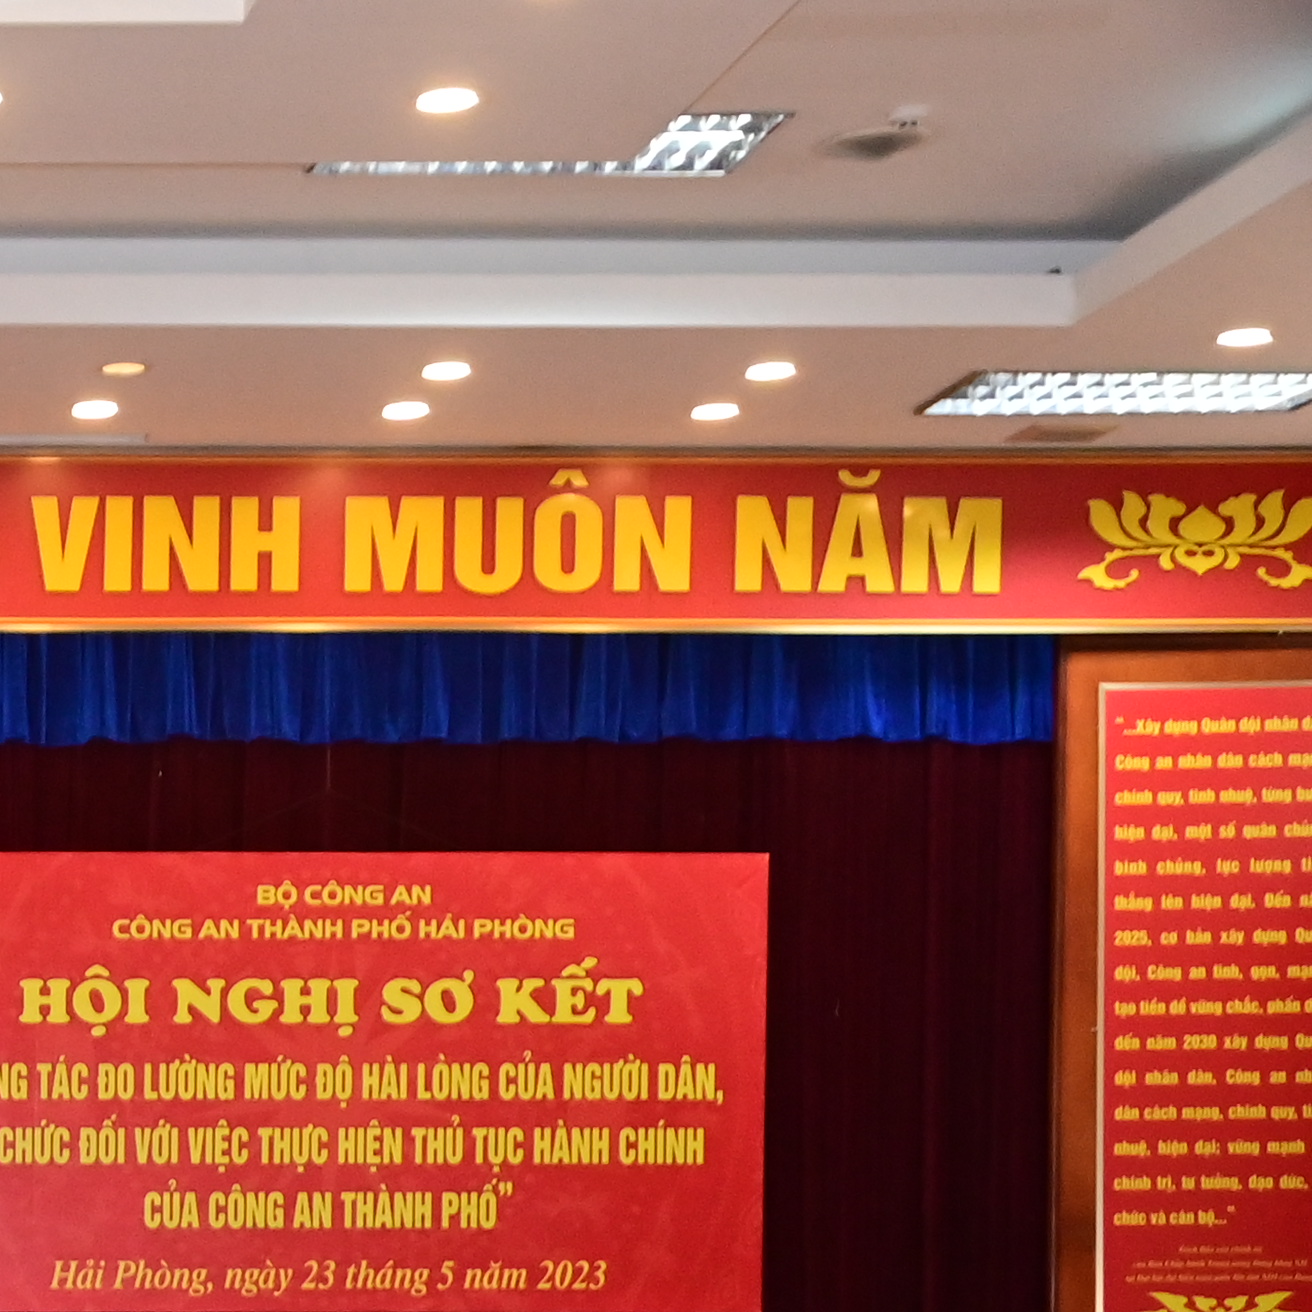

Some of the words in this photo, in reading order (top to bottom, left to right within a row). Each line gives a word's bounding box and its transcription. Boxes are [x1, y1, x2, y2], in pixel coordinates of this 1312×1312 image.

[31, 496, 300, 592] VINH
[344, 471, 691, 594] MUÔN
[735, 471, 1002, 594] NĂM
[257, 880, 297, 910] BỘ
[304, 880, 384, 906] CÔNG
[390, 885, 431, 905] AN
[113, 914, 192, 939] CÔNG
[199, 919, 239, 939] AN
[247, 914, 343, 939] THÀNH
[352, 911, 411, 939] PHỐ
[419, 914, 465, 939] HẢI
[474, 914, 574, 939] PHÒNG
[19, 965, 149, 1036] HỘI
[172, 978, 359, 1037] NGHỊ
[381, 970, 474, 1024] SƠ
[496, 957, 643, 1024] KẾT
[1183, 1034, 1218, 1049] 2030
[37, 1056, 88, 1100] TÁC
[98, 1063, 134, 1100] ĐO
[144, 1054, 234, 1100] LƯỜNG
[245, 1055, 306, 1100] MỨC
[316, 1055, 352, 1108] ĐỘ
[362, 1055, 407, 1100] HÀI
[417, 1054, 489, 1100] LÒNG
[499, 1051, 554, 1100] CỦA
[564, 1054, 648, 1100] NGƯỜI
[658, 1055, 723, 1104] DÂN,
[79, 1114, 125, 1164] ĐỐI
[135, 1120, 178, 1164] VỚI
[188, 1119, 249, 1172] VIỆC
[258, 1124, 328, 1172] THỰC
[338, 1120, 402, 1172] HIỆN
[411, 1115, 463, 1164] THỦ
[472, 1127, 524, 1172] TỤC
[534, 1120, 609, 1164] HÀNH
[619, 1120, 704, 1165] CHÍNH
[144, 1179, 199, 1229] CỦA
[209, 1184, 284, 1229] CÔNG
[293, 1192, 332, 1229] AN
[341, 1184, 432, 1228] THÀNH
[51, 1259, 105, 1289] Hải
[113, 1260, 213, 1296] Phòng,
[225, 1260, 293, 1296] ngày
[301, 1260, 336, 1289] 23
[346, 1260, 429, 1296] tháng
[437, 1261, 454, 1290] 5
[464, 1261, 526, 1289] năm
[537, 1260, 606, 1290] 2023
